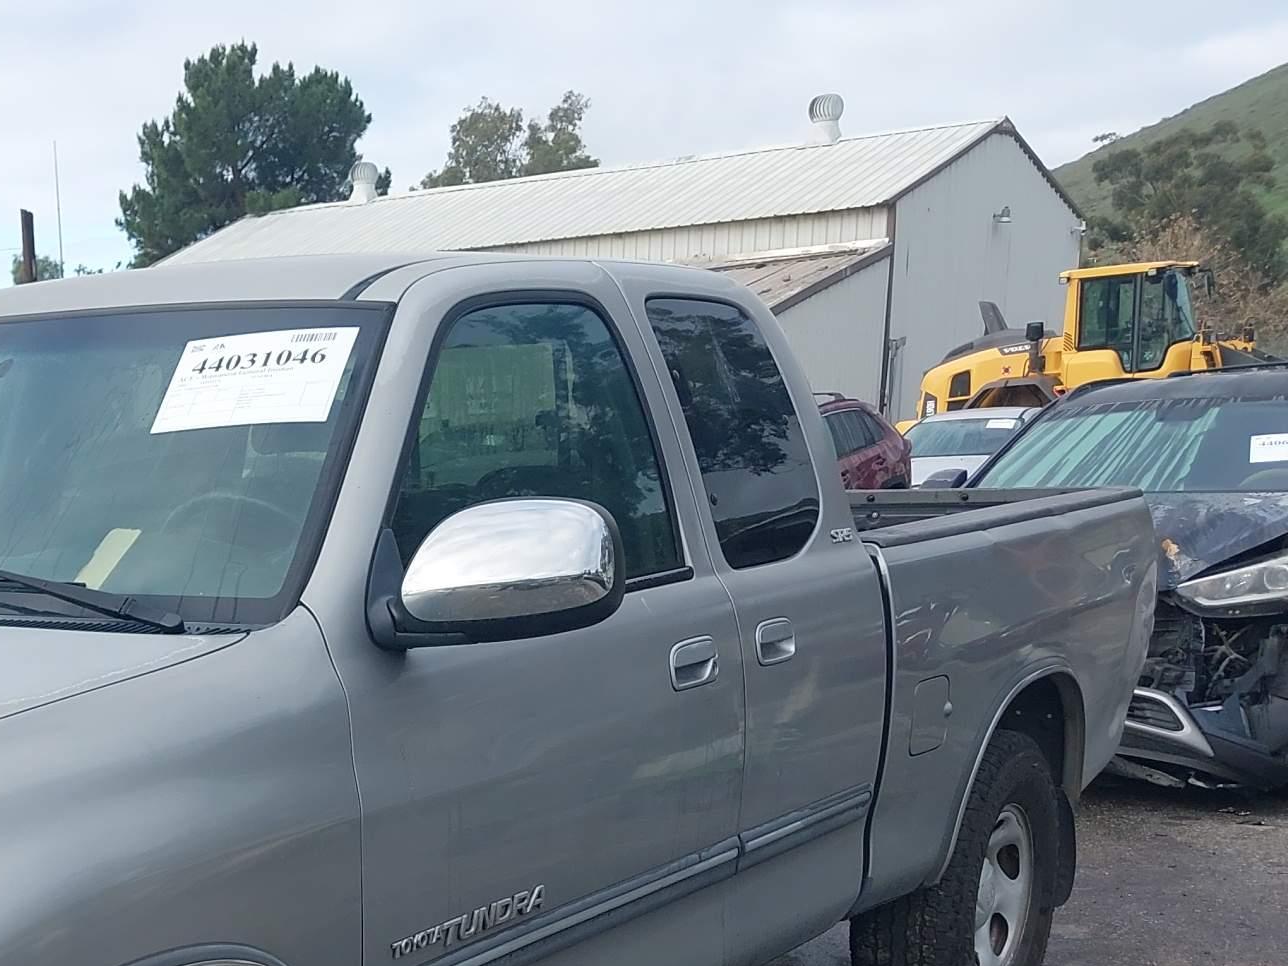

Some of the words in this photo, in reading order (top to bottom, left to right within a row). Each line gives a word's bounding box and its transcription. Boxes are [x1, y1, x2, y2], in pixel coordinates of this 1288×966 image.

[192, 347, 328, 374] 44031046
[1003, 344, 1031, 354] VOLV
[391, 925, 443, 959] TOYOTA
[443, 884, 545, 946] TUNDRA
